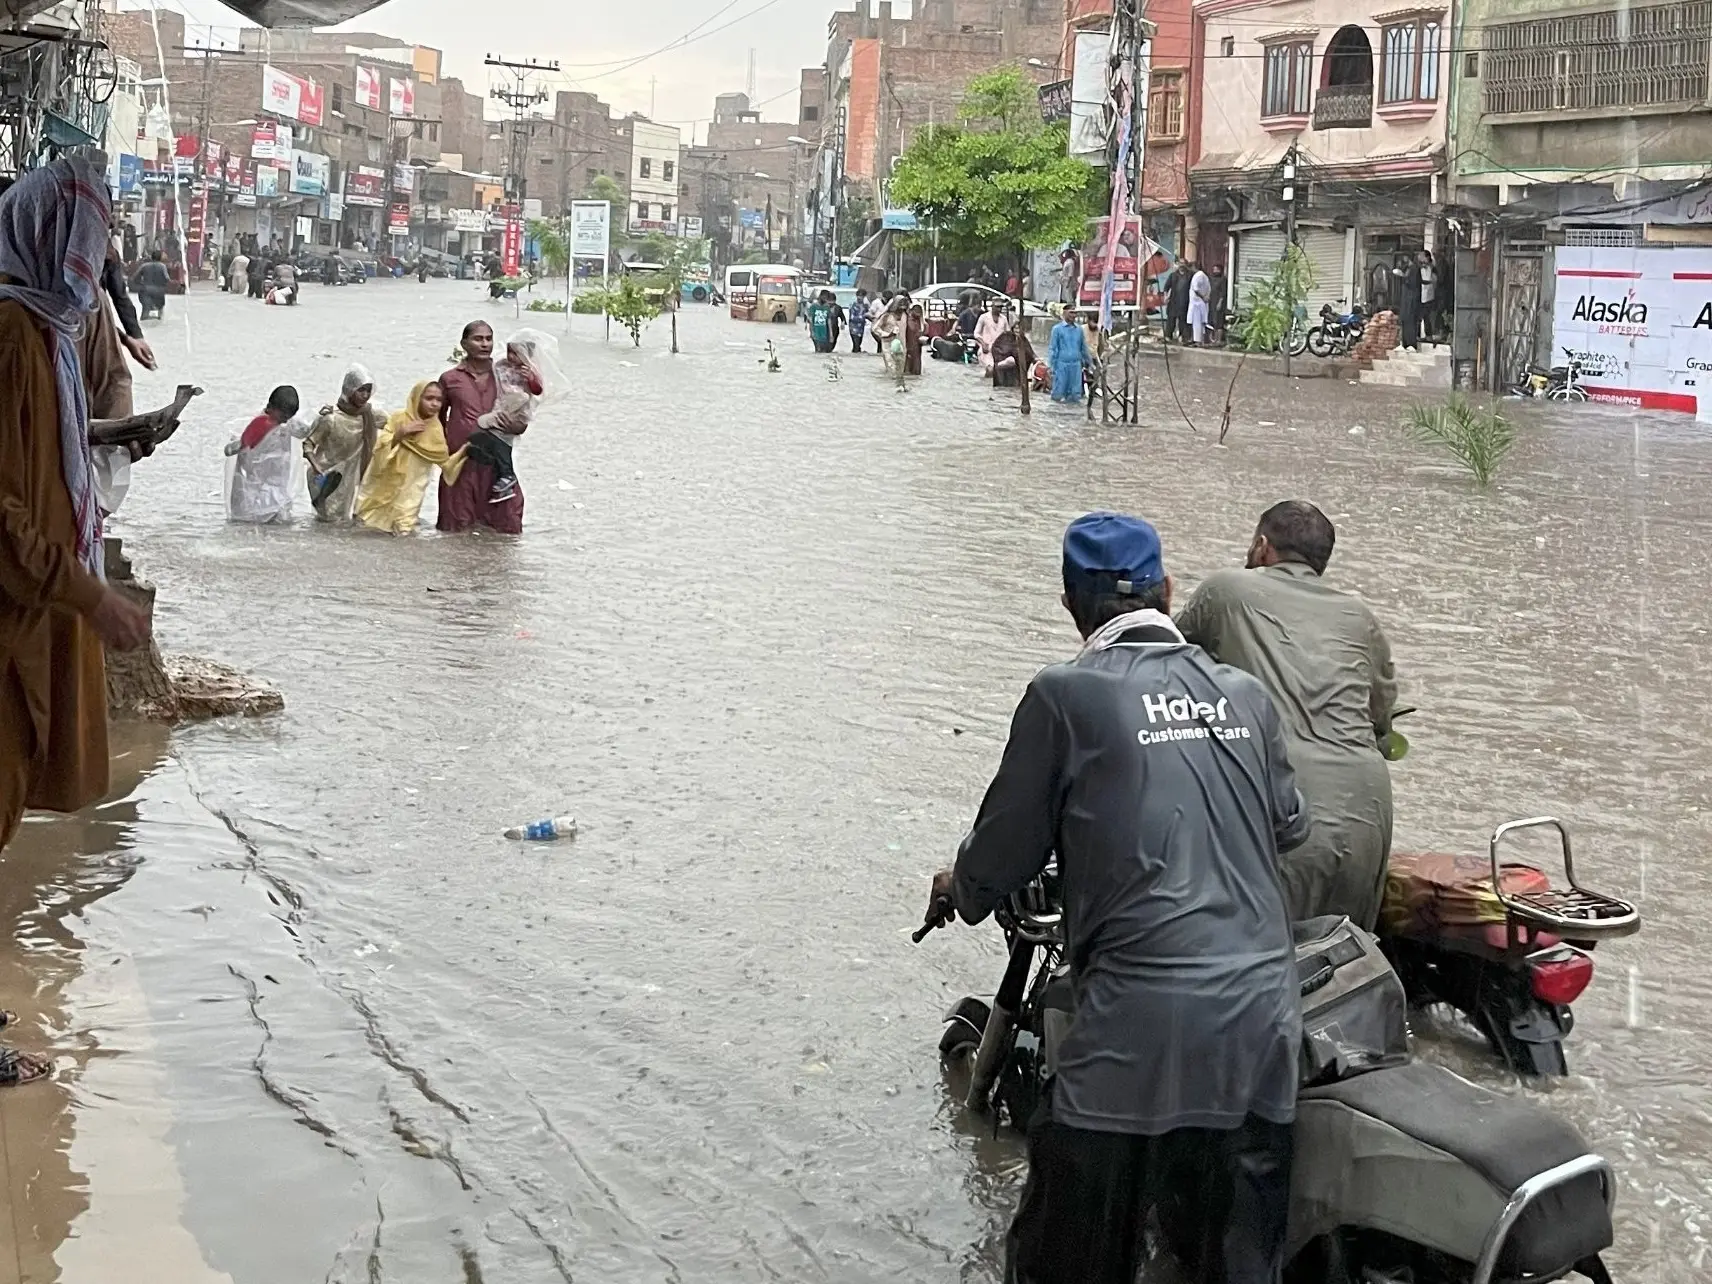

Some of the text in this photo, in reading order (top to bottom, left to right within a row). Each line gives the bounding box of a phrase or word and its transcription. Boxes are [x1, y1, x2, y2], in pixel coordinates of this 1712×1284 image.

[1572, 295, 1648, 324] Alaska
[1141, 692, 1228, 724] Haier
[1137, 725, 1251, 745] Customer Care
